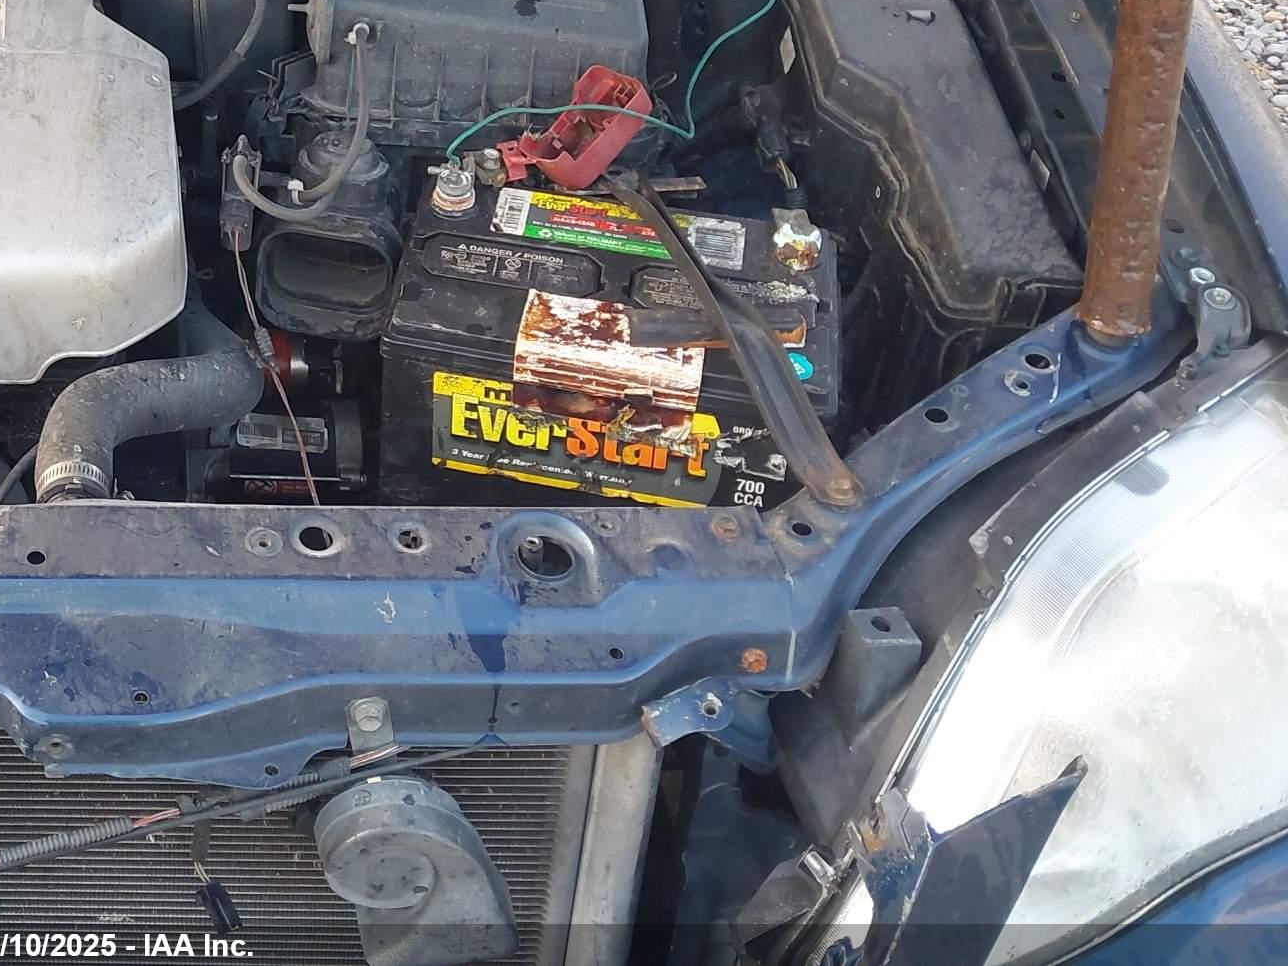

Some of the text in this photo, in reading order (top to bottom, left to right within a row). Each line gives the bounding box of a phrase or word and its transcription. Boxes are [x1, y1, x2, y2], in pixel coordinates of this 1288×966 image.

[469, 244, 512, 256] DANGER
[523, 252, 564, 264] POISON
[462, 448, 485, 461] Year
[735, 478, 765, 494] 700
[733, 493, 763, 507] CCA
